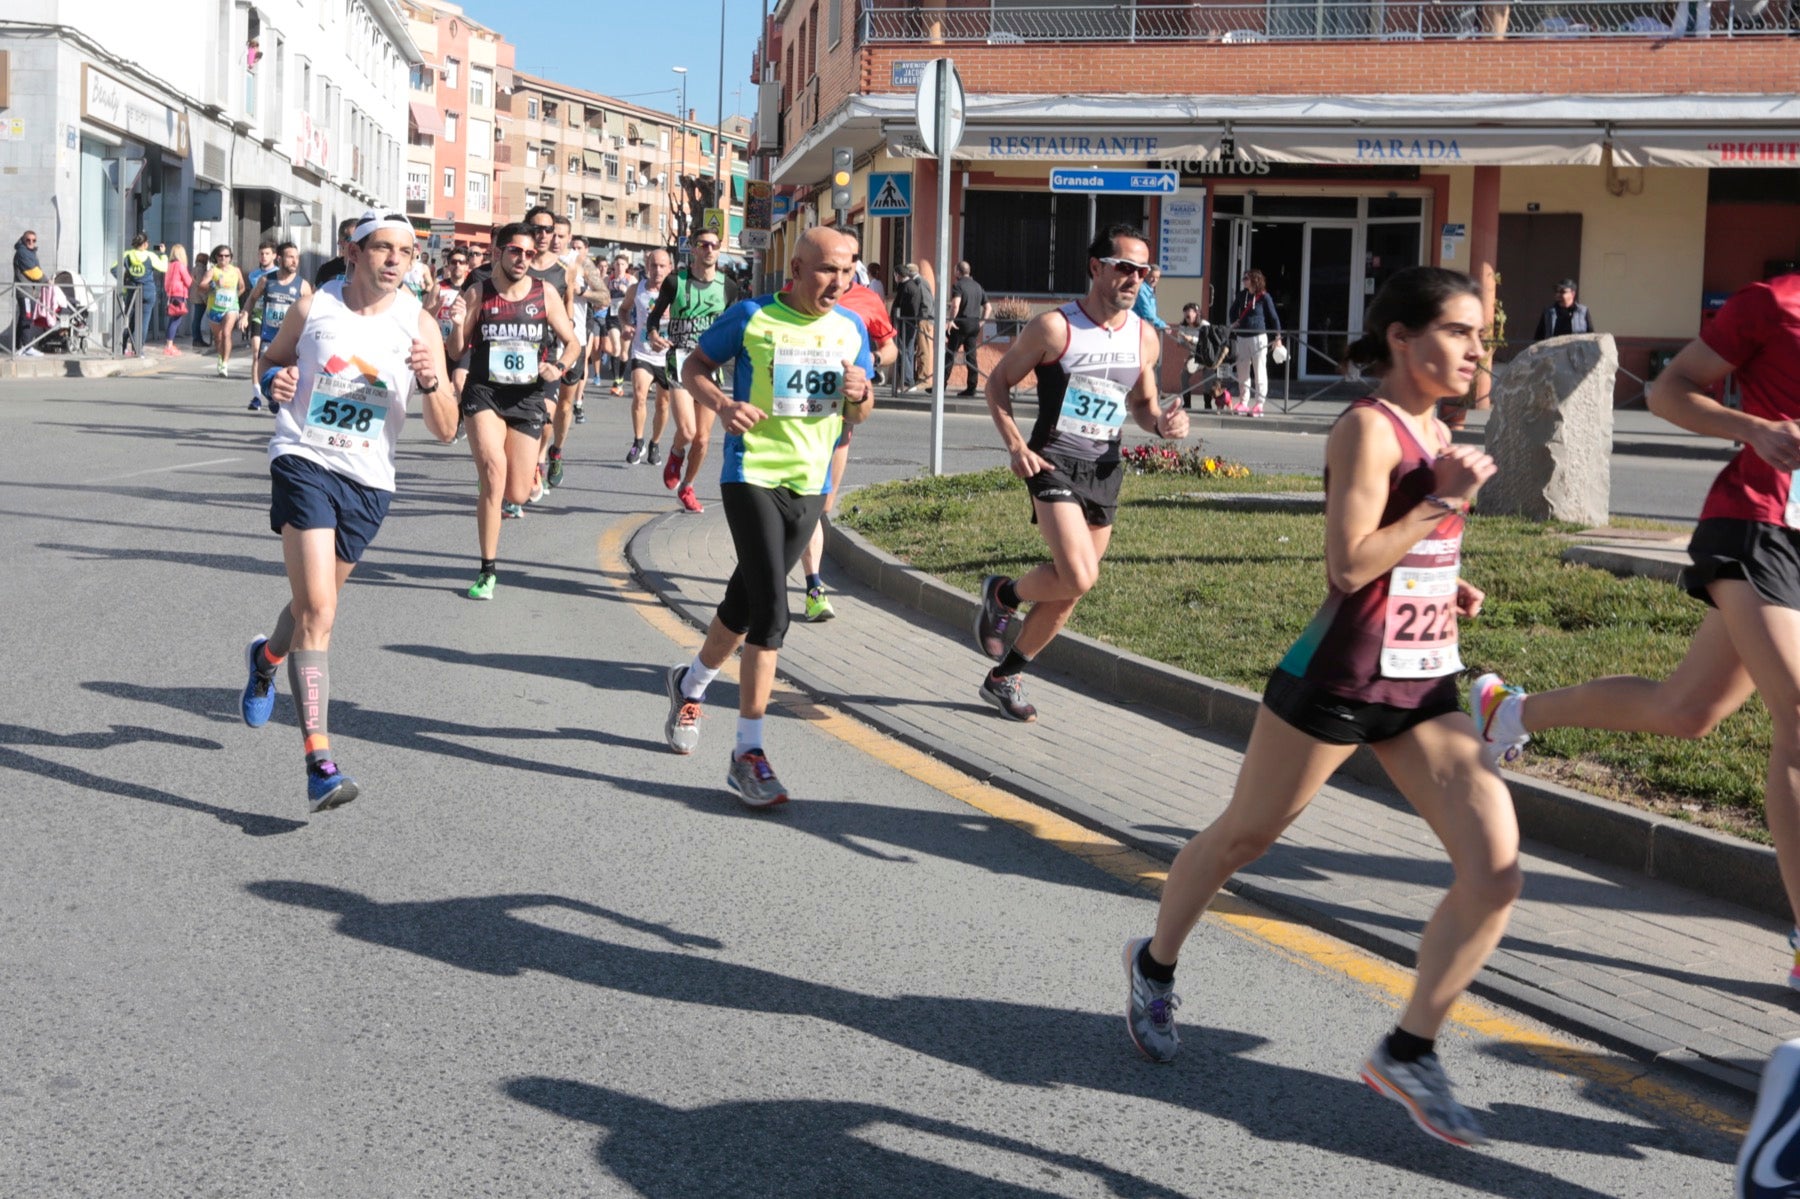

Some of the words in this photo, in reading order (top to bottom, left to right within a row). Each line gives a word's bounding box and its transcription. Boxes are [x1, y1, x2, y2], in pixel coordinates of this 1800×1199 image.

[988, 136, 1159, 155] RESTAURANTE
[1356, 139, 1461, 158] PARADA
[1053, 174, 1104, 187] Granada
[1132, 178, 1155, 186] A-44
[503, 354, 525, 371] 68
[786, 369, 837, 395] 468
[320, 400, 374, 433] 528
[1074, 395, 1118, 422] 377
